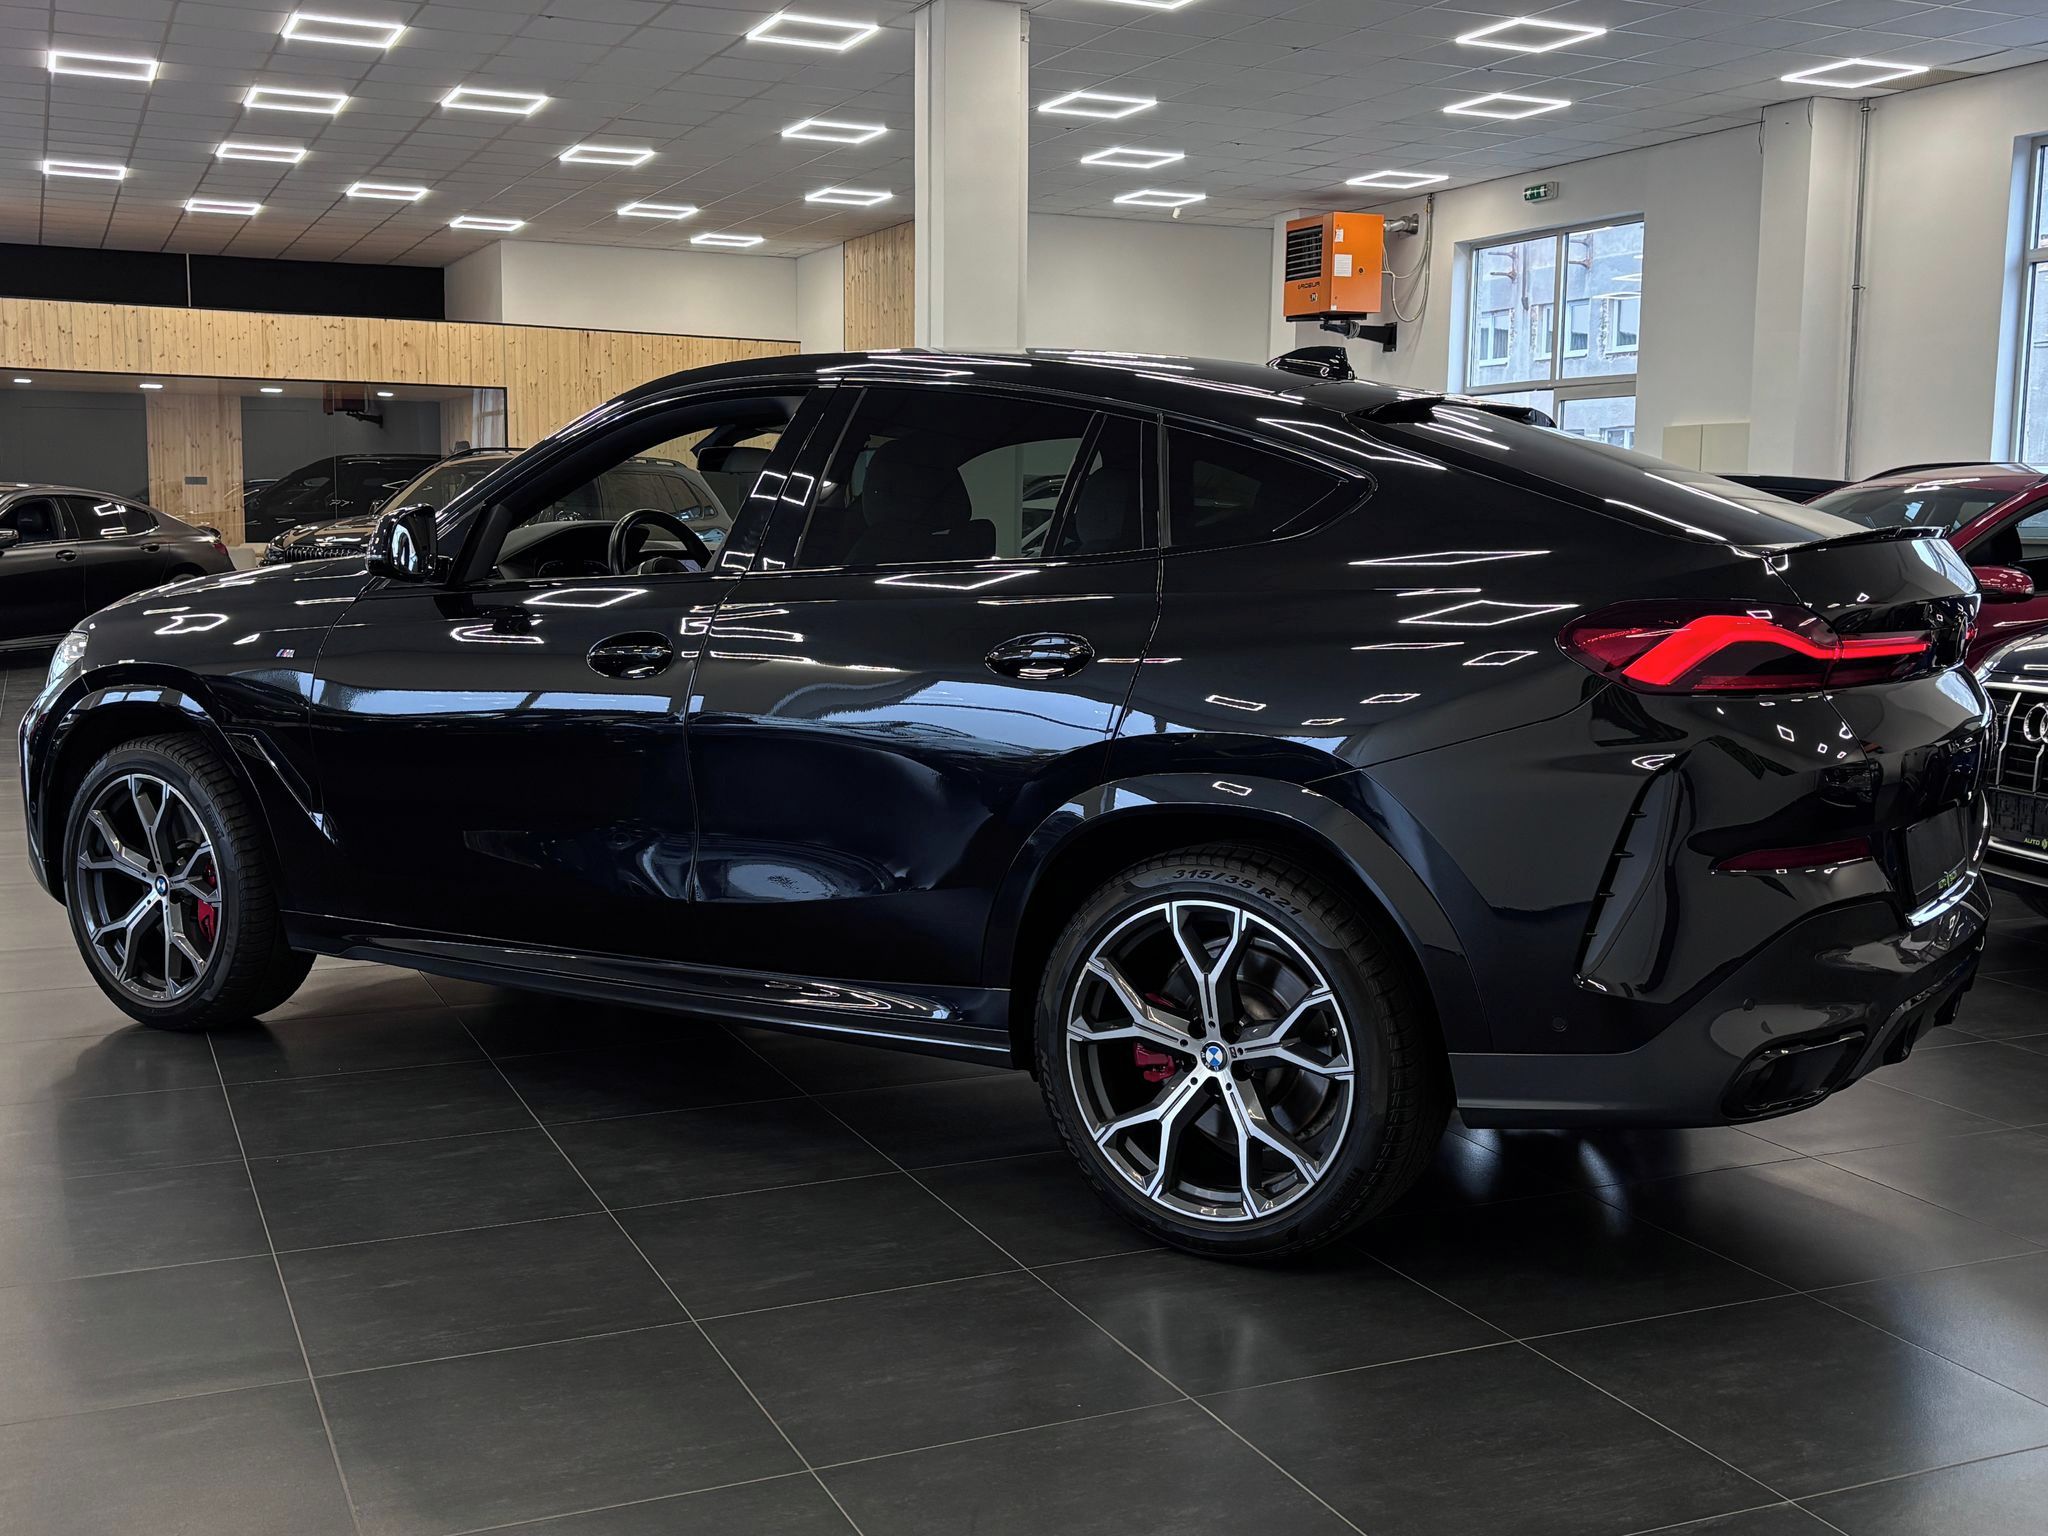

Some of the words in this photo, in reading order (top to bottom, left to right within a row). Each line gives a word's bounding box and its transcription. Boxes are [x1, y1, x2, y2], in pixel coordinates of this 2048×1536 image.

[2023, 837, 2041, 847] AUTO
[1172, 868, 1256, 889] 315/35
[1256, 886, 1303, 916] R21
